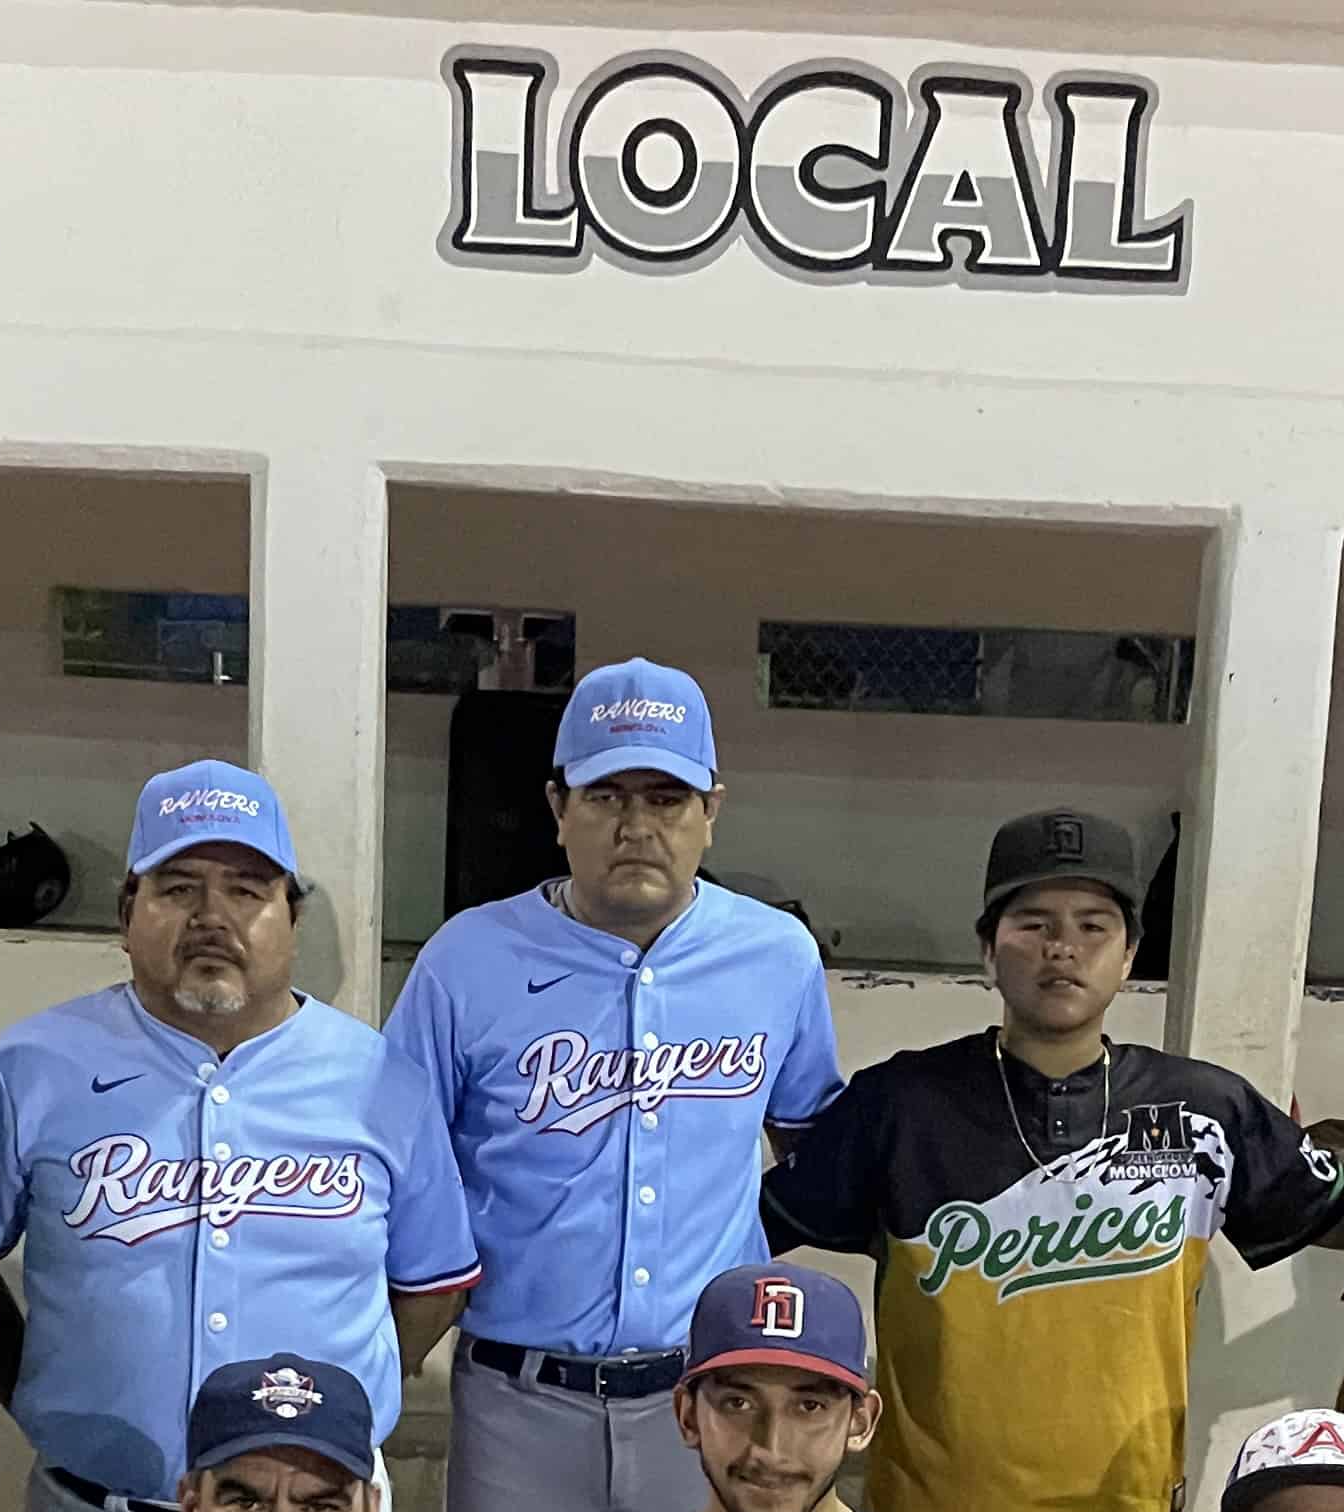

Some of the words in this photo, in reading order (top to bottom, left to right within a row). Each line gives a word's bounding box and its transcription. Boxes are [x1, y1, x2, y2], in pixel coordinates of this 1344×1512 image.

[444, 48, 1190, 290] LOCAL
[590, 698, 686, 724] RANGERS
[158, 788, 260, 817] RANGERS
[514, 1029, 768, 1124] Rangers
[61, 1132, 365, 1228] Rangers
[1109, 1163, 1197, 1180] MONCLOV
[915, 1193, 1187, 1297] Pericos
